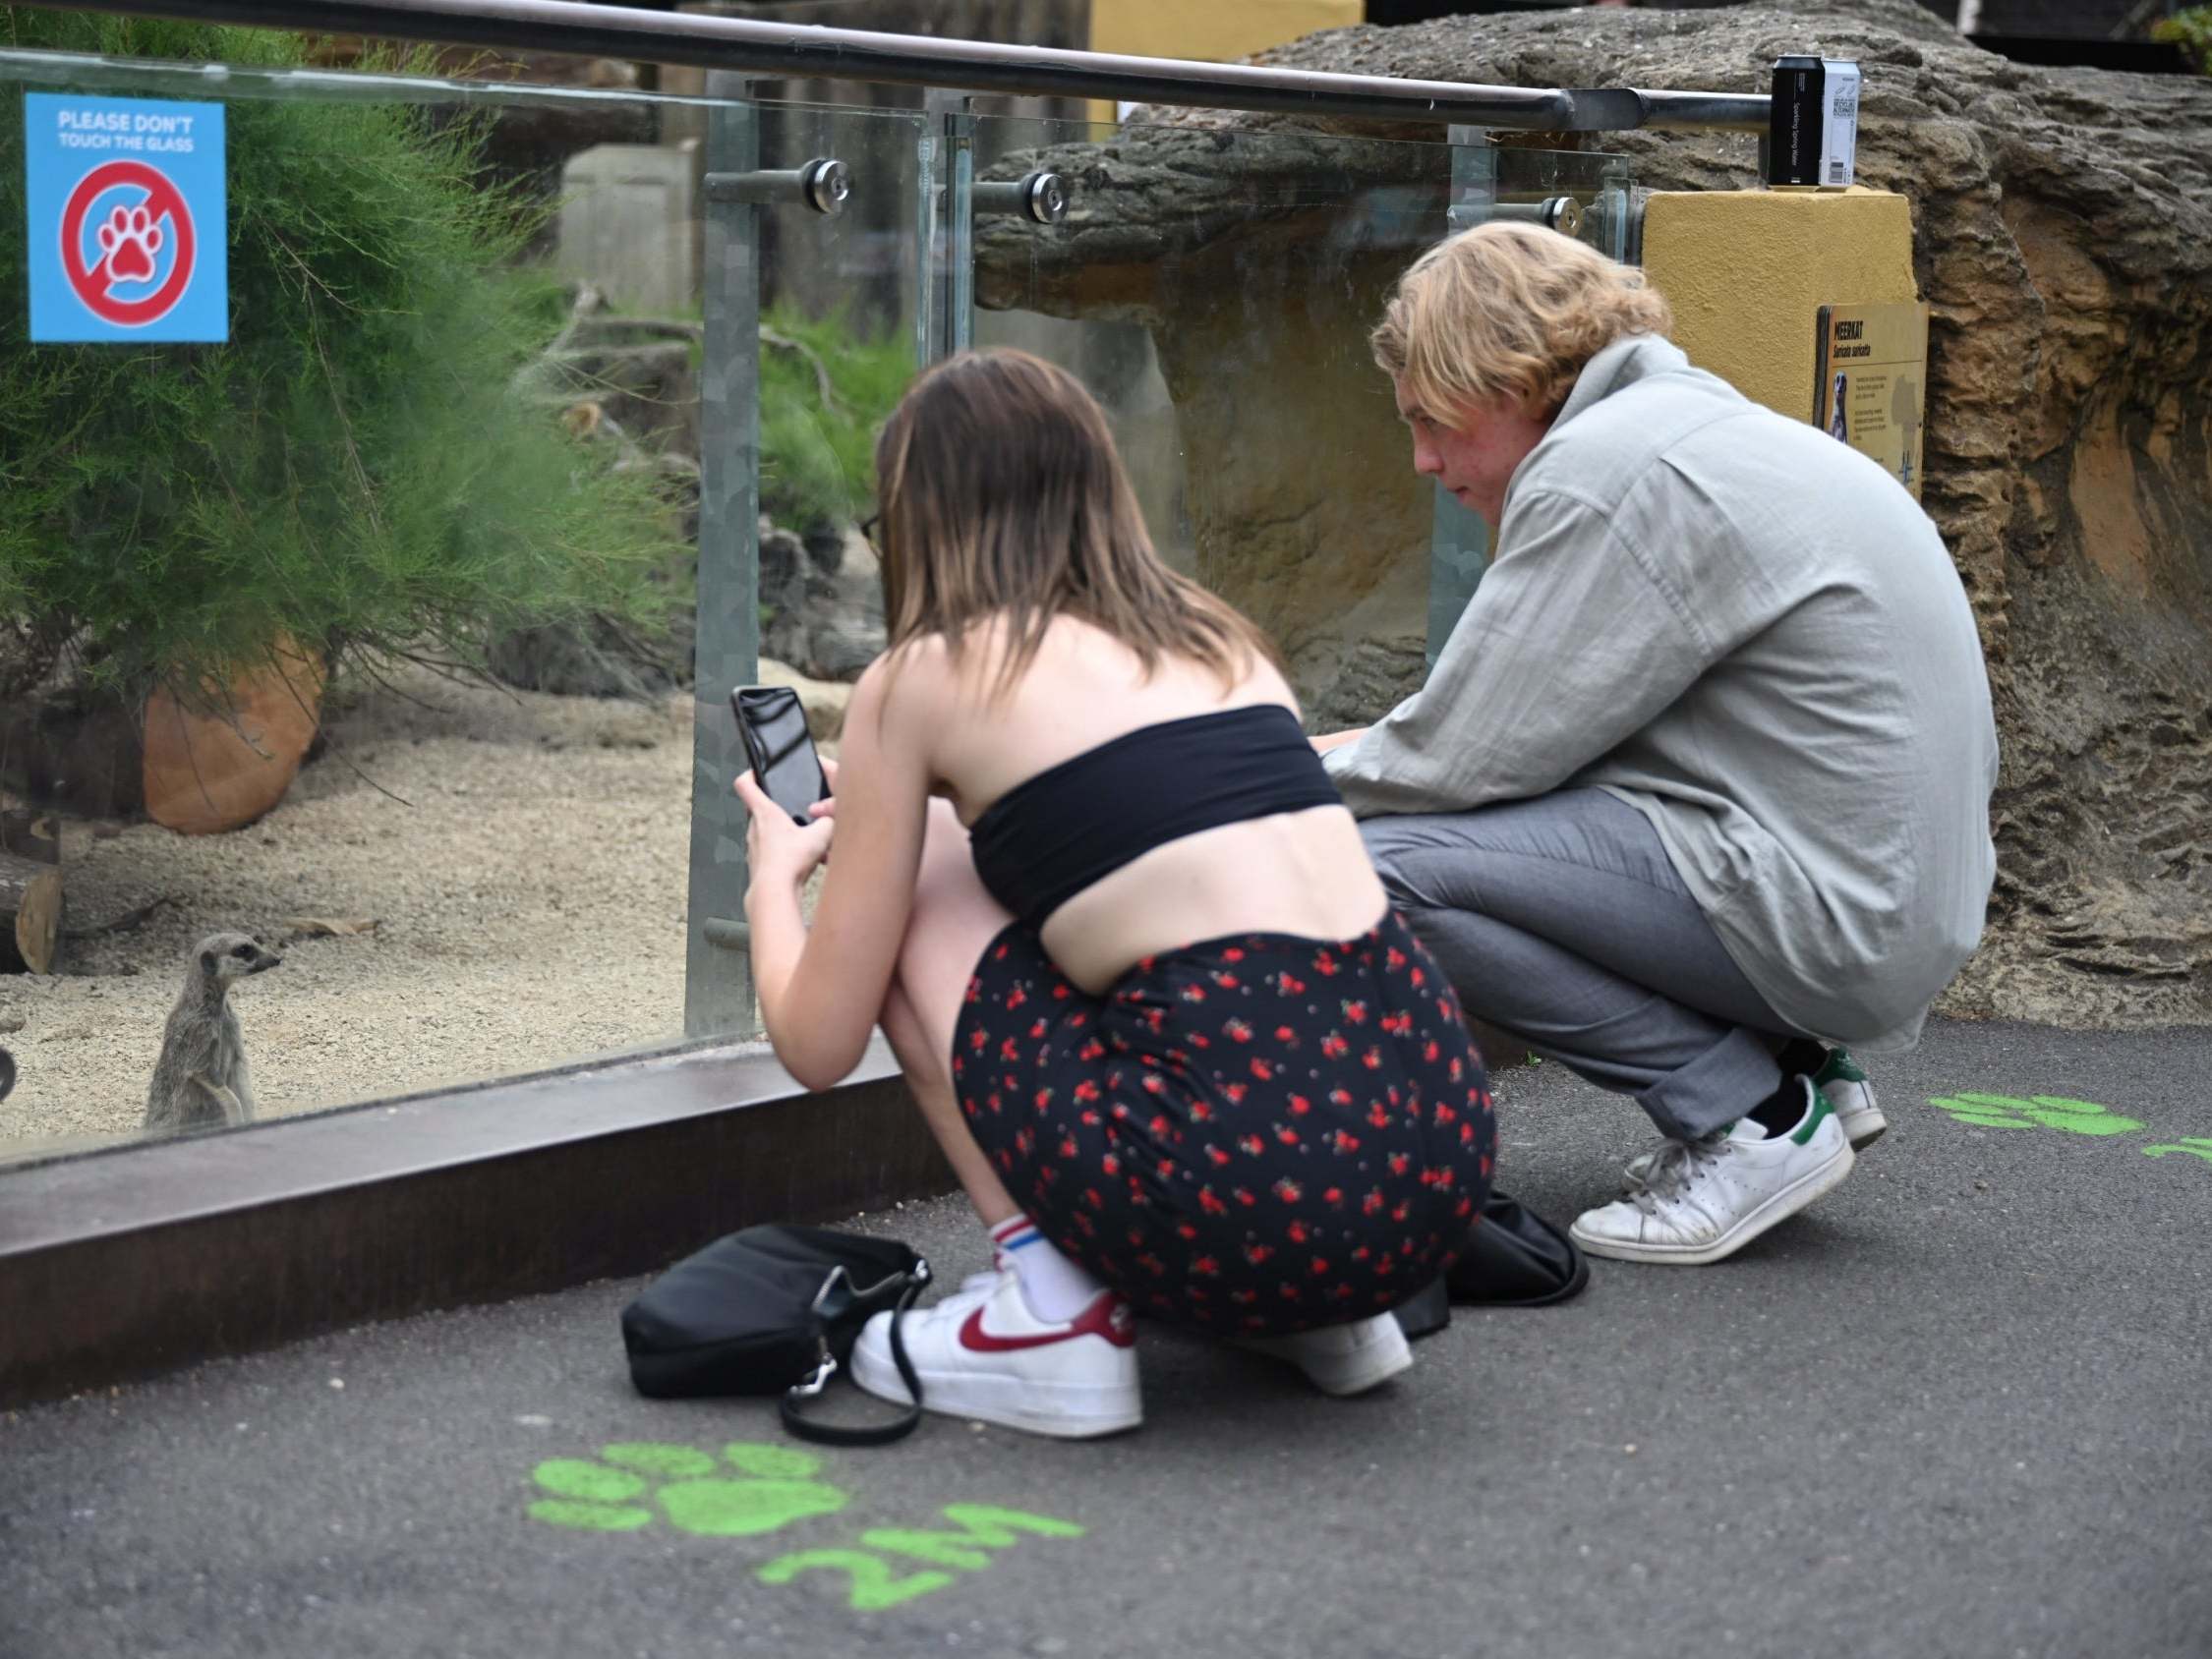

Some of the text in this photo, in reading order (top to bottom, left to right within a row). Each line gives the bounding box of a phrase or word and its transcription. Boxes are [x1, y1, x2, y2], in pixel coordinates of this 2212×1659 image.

[58, 111, 194, 134] PLEASE DON'T
[59, 133, 194, 152] TOUCH THE GLASS
[1834, 320, 1864, 340] MEERKAT
[758, 1503, 1082, 1611] 2M
